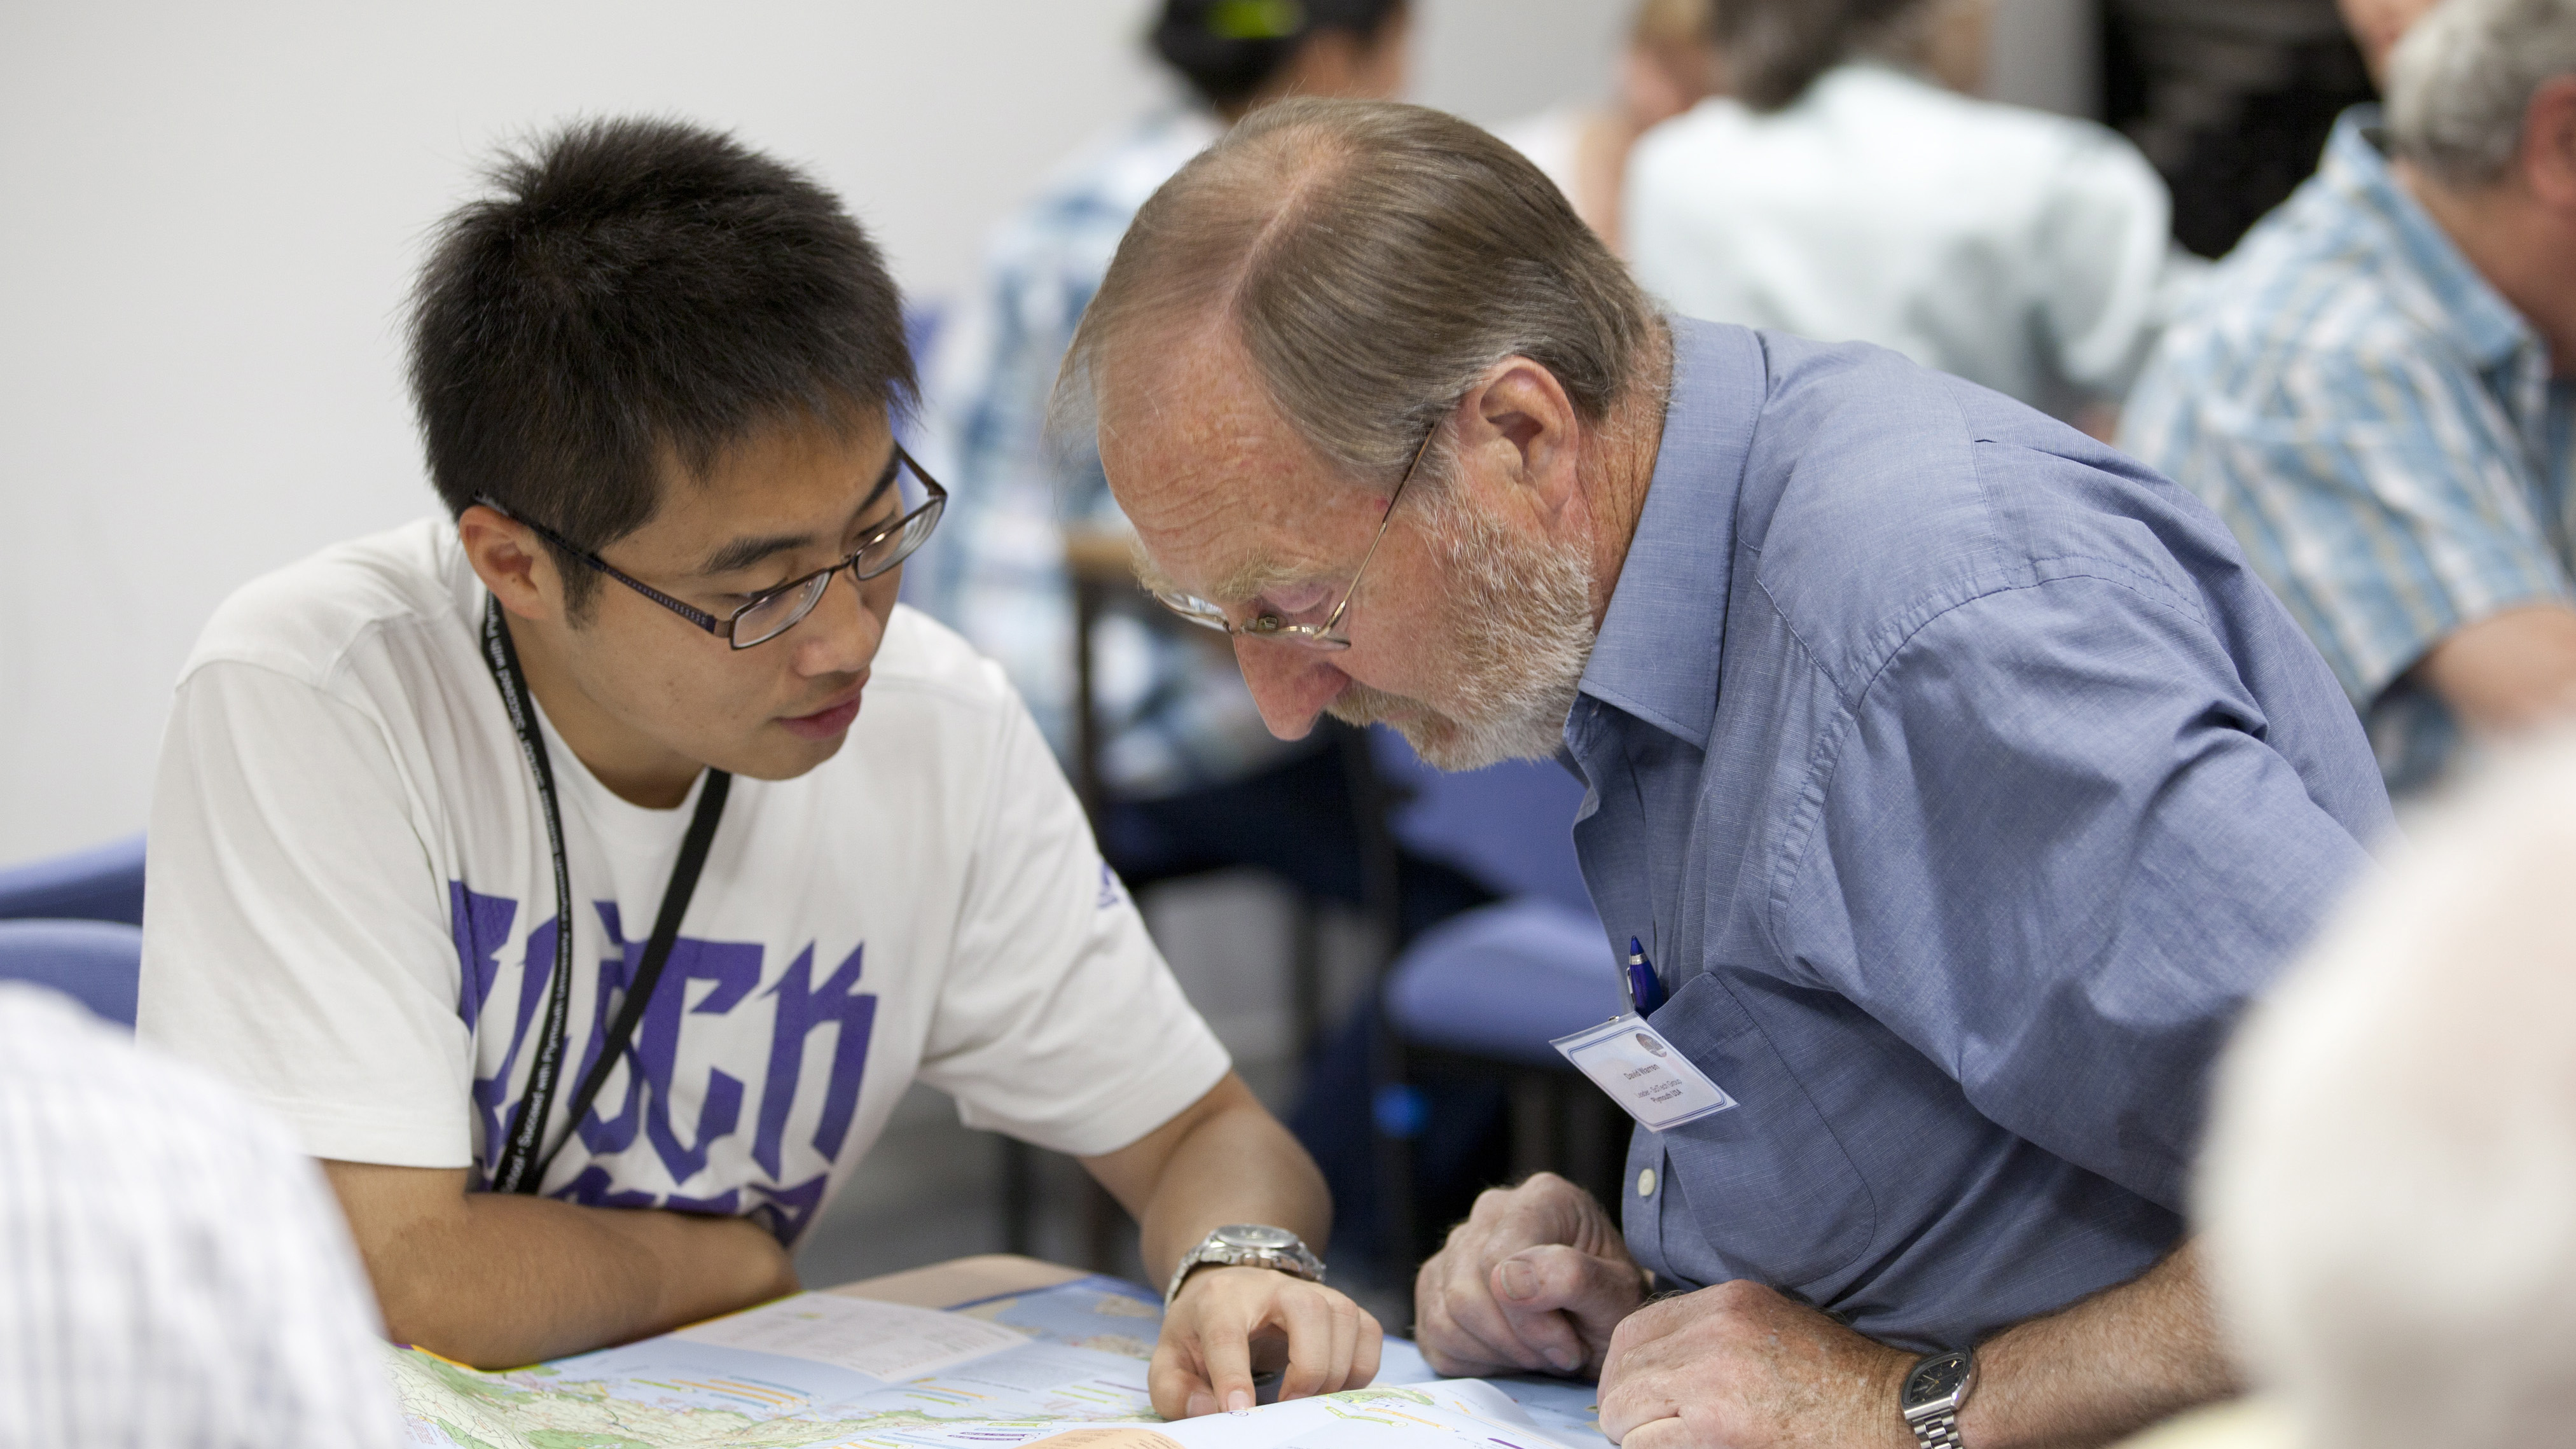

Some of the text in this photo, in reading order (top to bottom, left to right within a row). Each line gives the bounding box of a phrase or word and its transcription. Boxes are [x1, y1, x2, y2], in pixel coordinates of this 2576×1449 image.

[490, 638, 506, 669] with
[497, 669, 526, 730] Succeed
[554, 931, 569, 999] University
[541, 999, 565, 1062] Plymouth
[537, 1063, 551, 1092] with
[1623, 1064, 1660, 1079] David Warren
[1666, 1079, 1682, 1087] Group
[516, 1091, 545, 1147] Succeed
